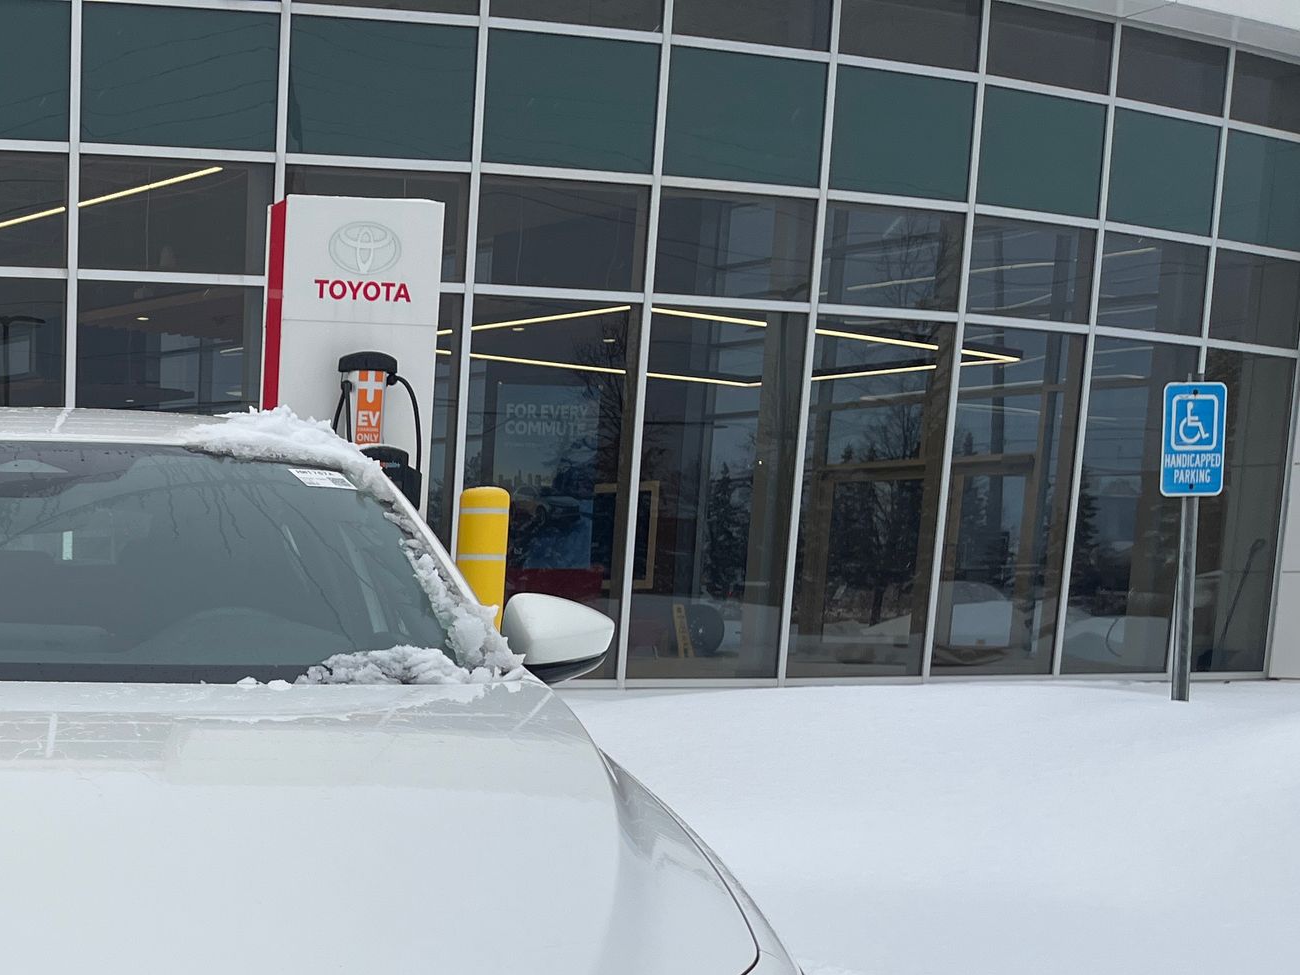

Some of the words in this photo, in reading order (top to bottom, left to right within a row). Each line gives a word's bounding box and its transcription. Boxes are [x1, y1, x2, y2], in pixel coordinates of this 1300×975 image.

[314, 279, 411, 303] TOYOTA
[357, 410, 380, 427] EV
[505, 403, 537, 418] FOR
[540, 404, 589, 420] EVERY
[504, 420, 588, 437] COMMUTE
[356, 433, 380, 442] ONLY
[1164, 453, 1221, 468] HANDICAPPED
[1173, 469, 1211, 484] PARKING
